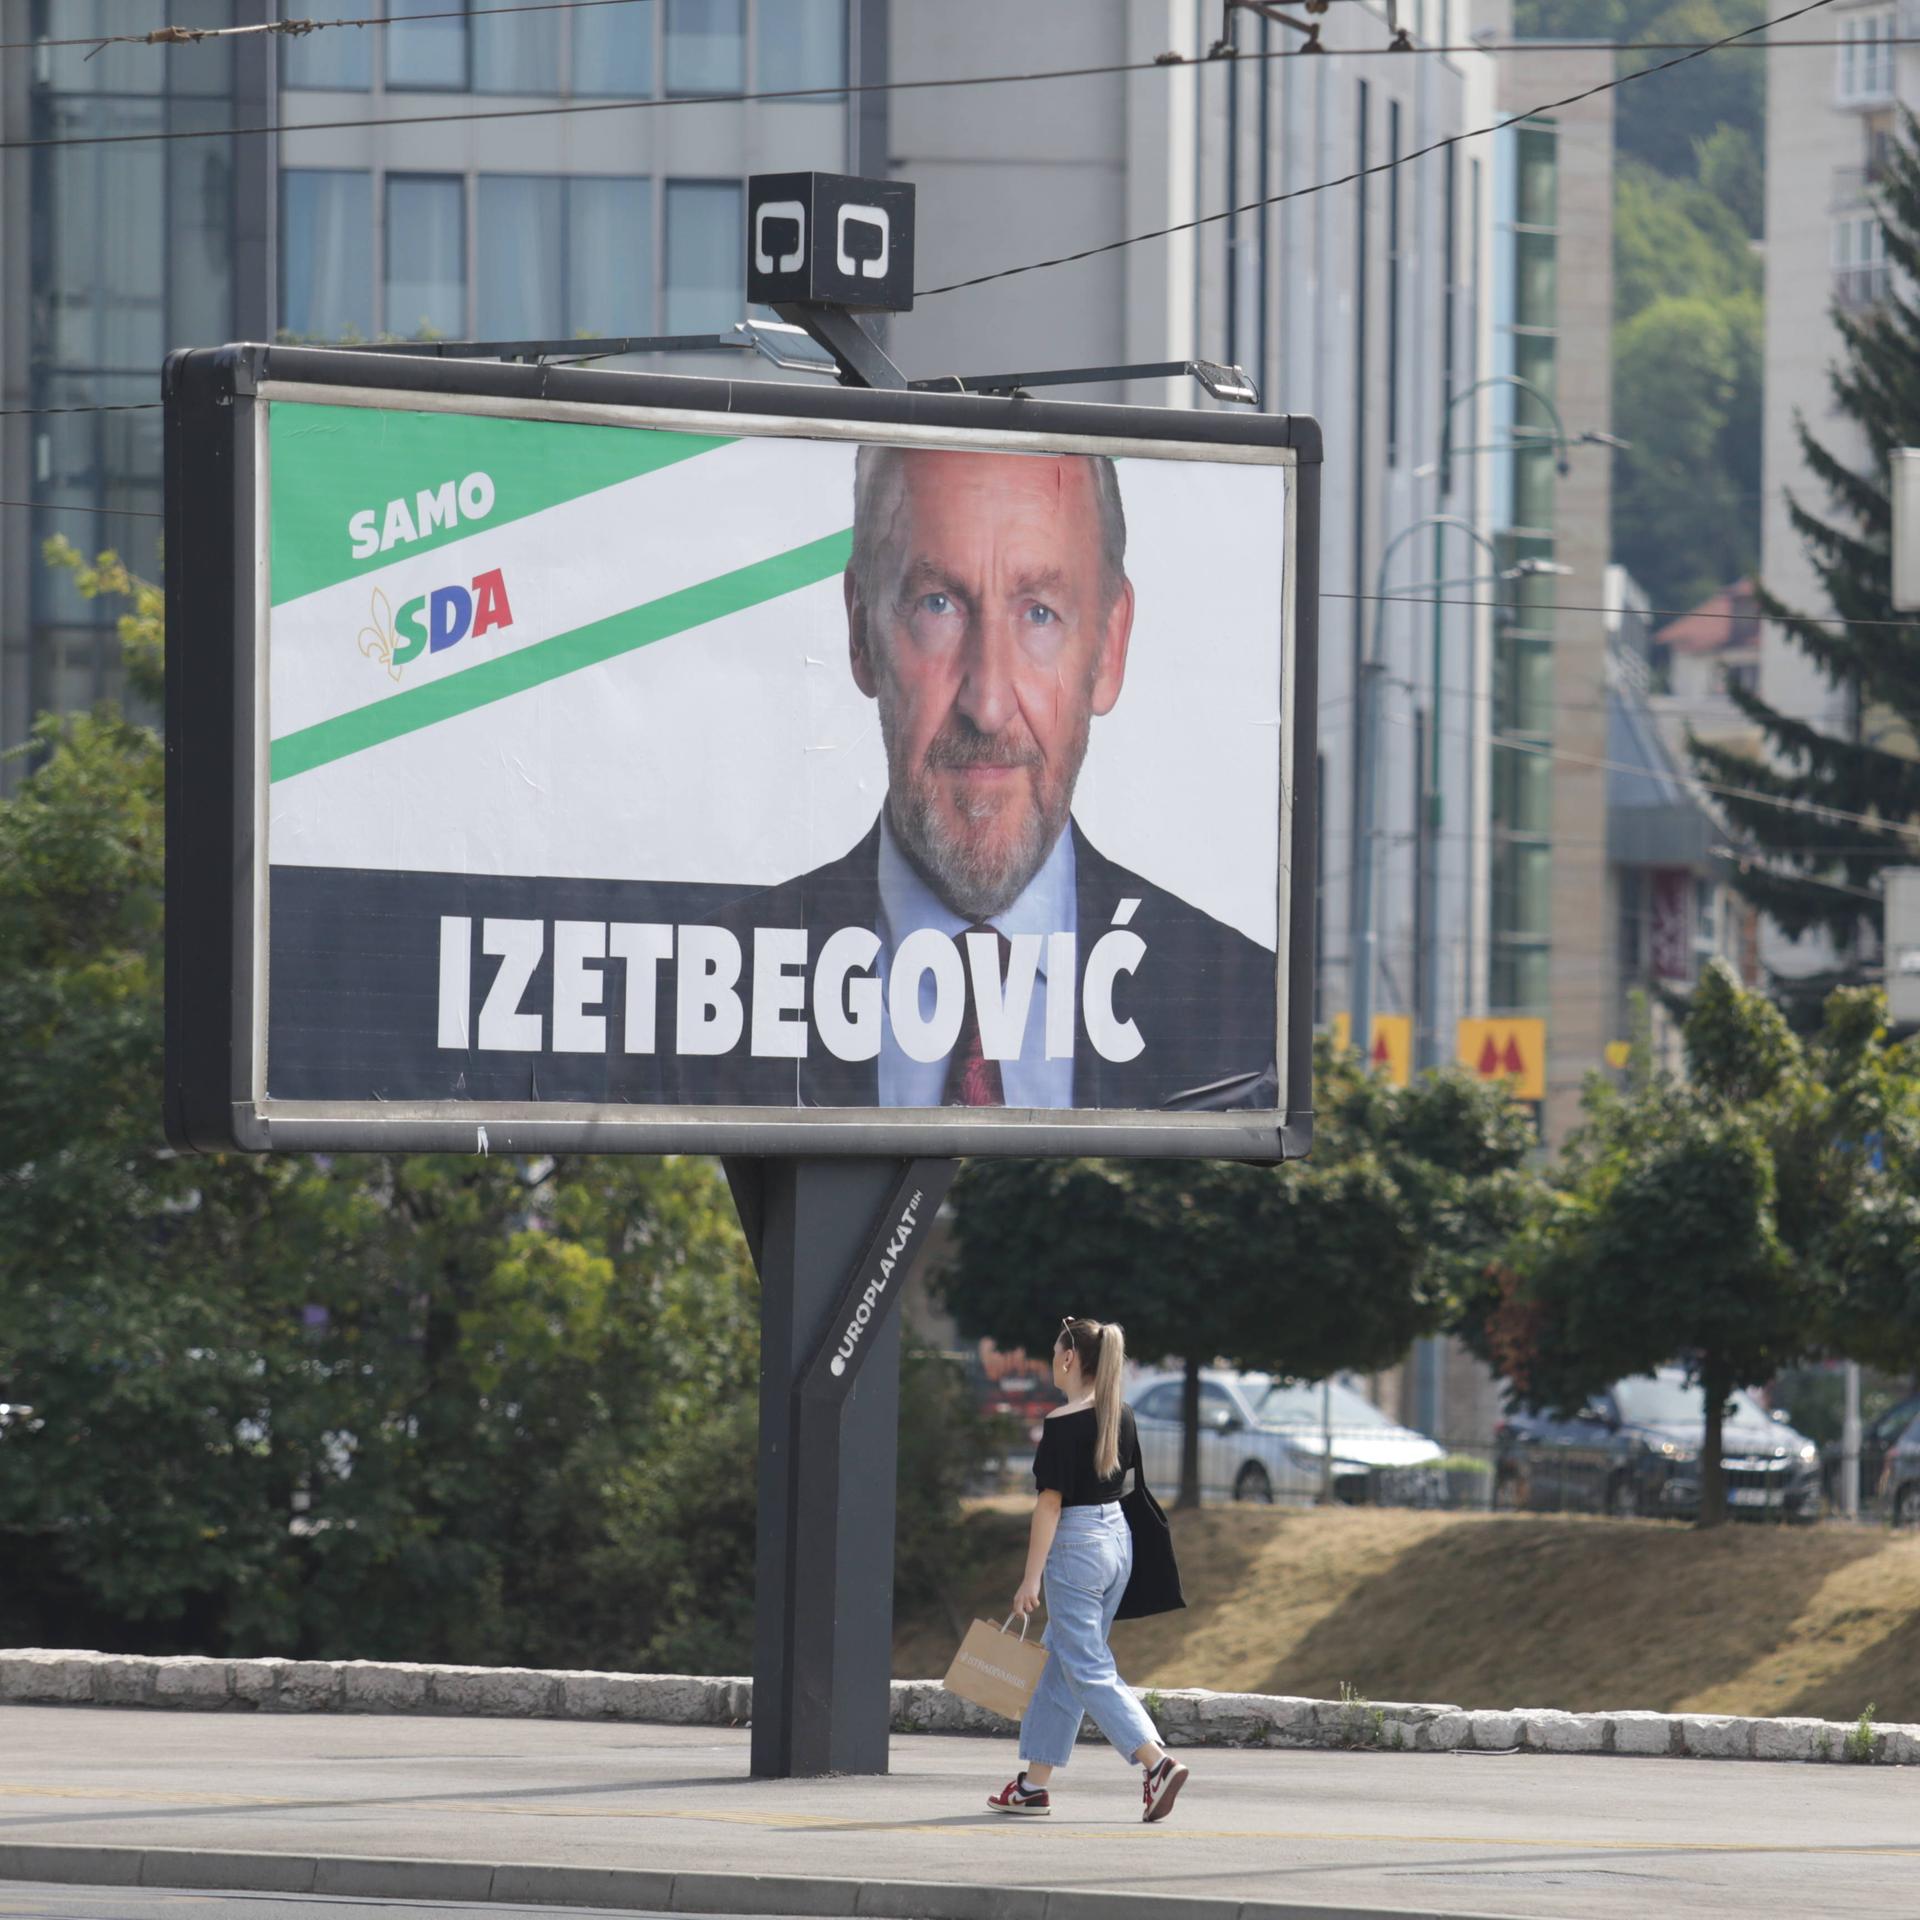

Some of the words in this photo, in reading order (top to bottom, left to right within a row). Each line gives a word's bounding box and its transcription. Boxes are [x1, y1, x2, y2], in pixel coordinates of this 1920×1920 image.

[348, 471, 496, 560] SAMO
[392, 567, 514, 666] SDA
[437, 898, 1149, 1064] IZETBEGOVIĆ
